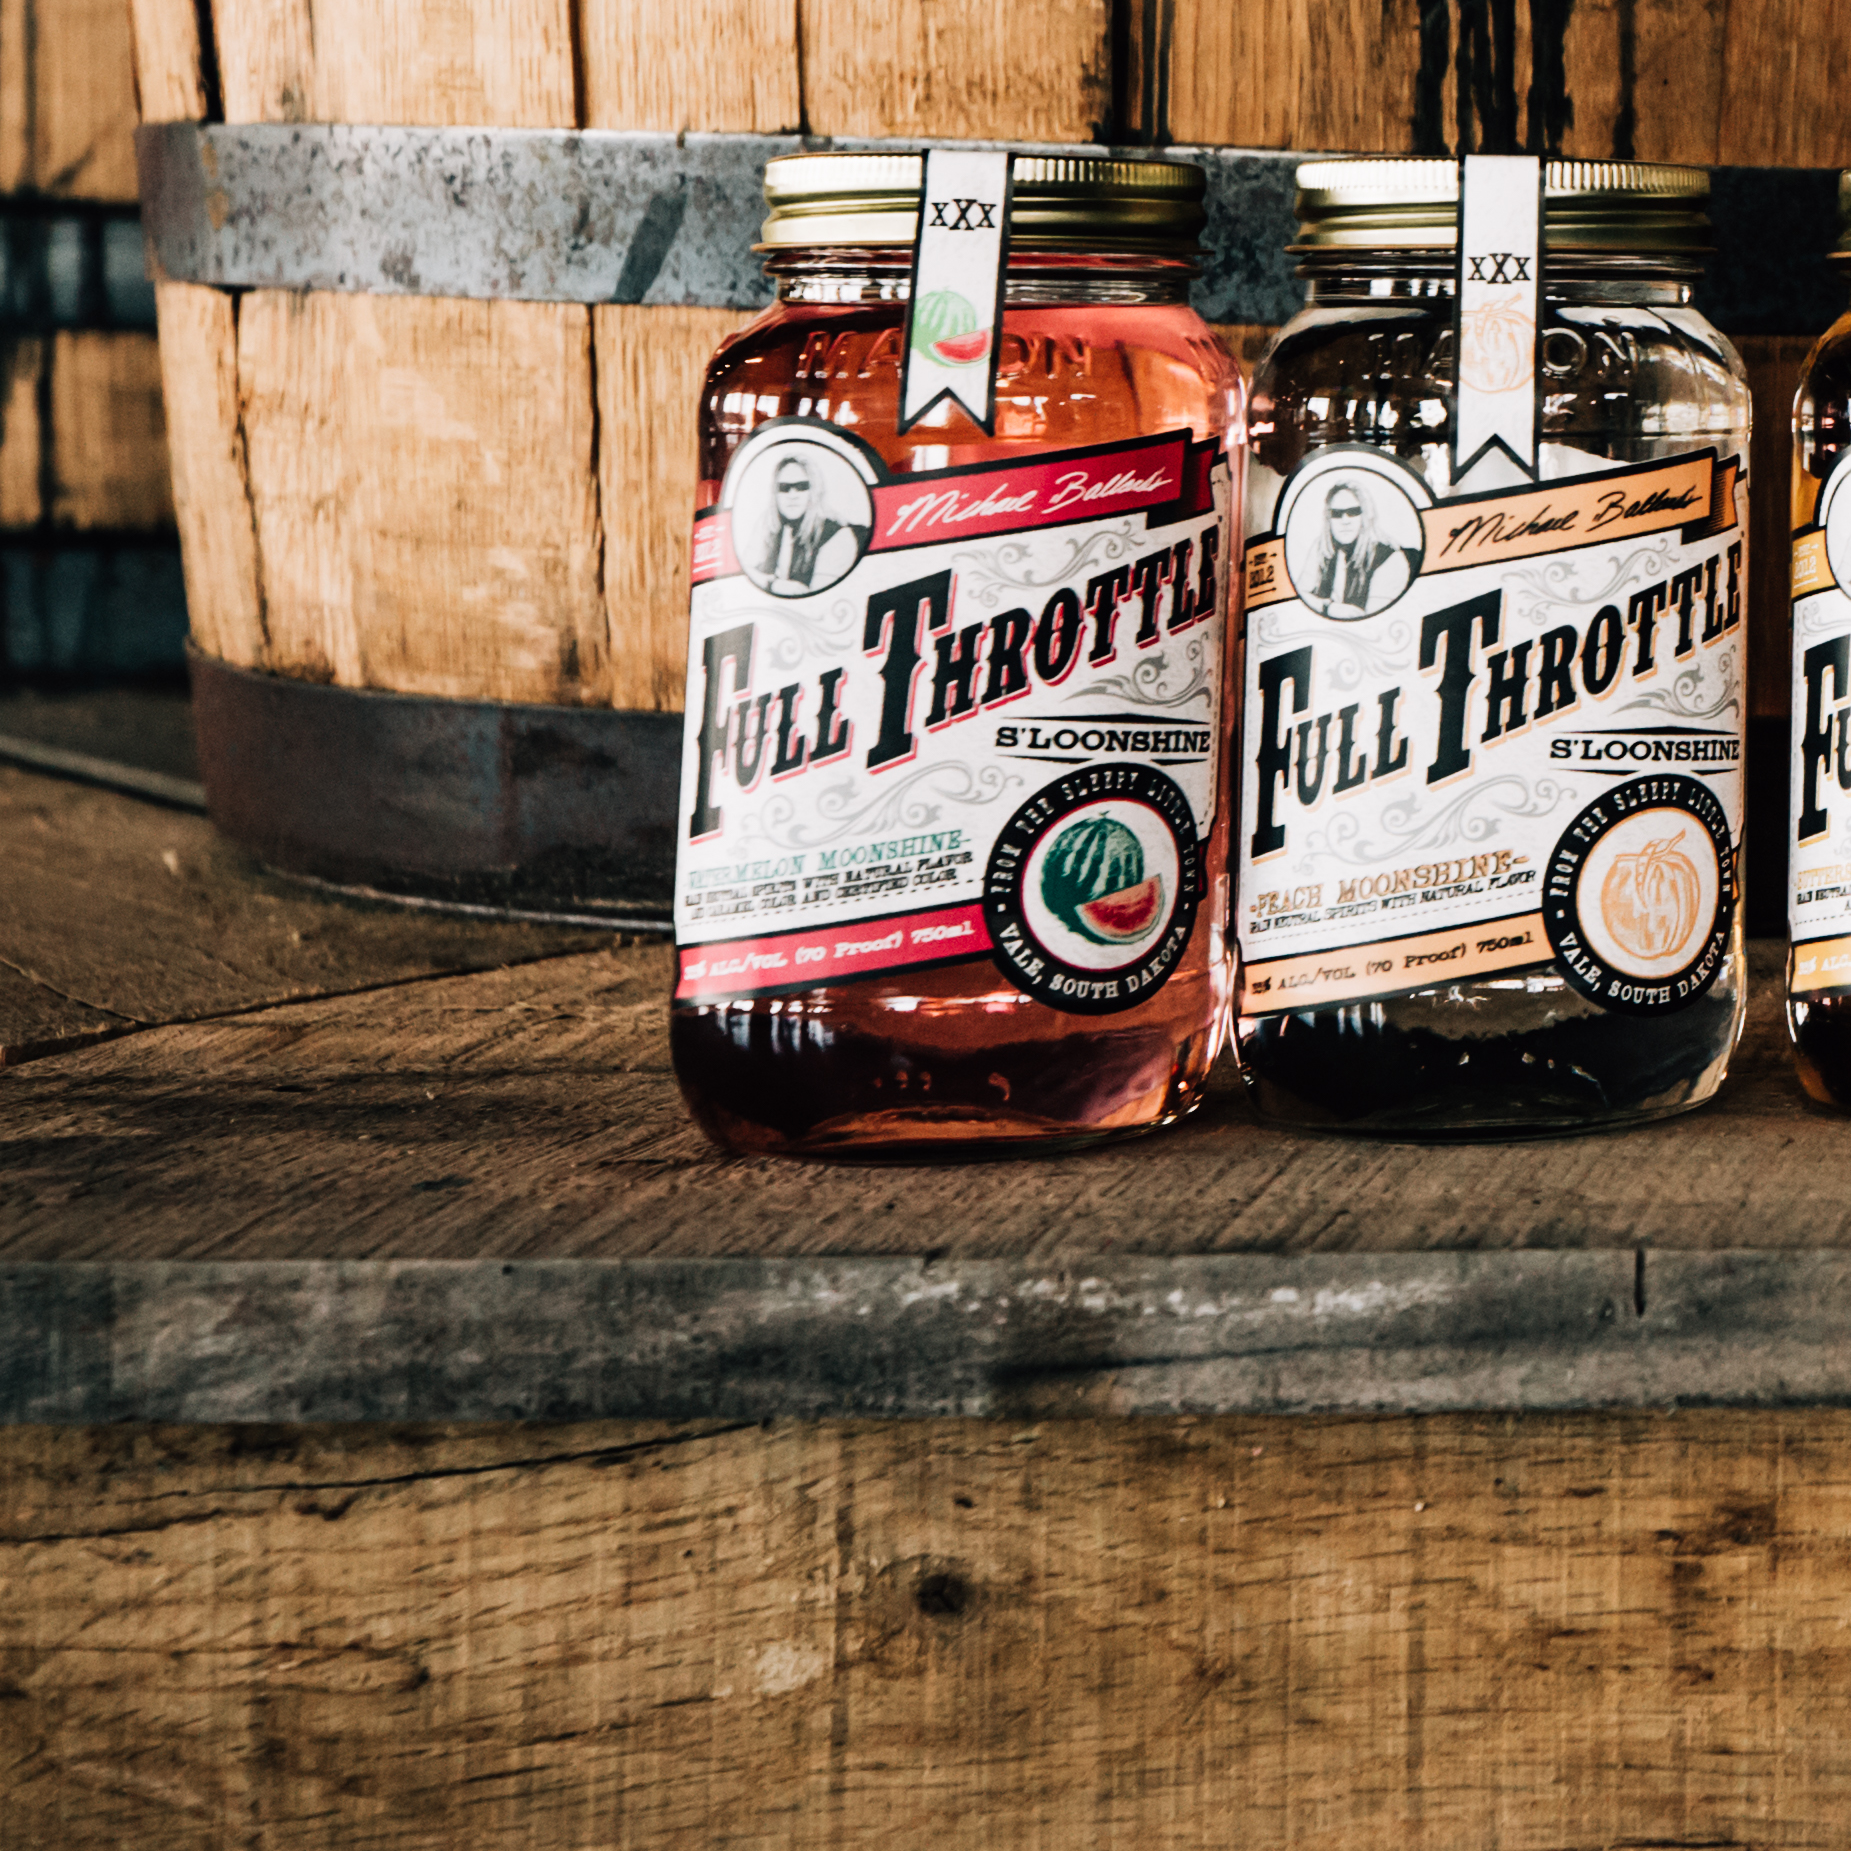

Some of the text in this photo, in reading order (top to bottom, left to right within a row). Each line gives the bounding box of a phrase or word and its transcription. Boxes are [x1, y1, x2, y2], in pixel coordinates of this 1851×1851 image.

[689, 525, 1218, 846] FULL THROTTLE
[1251, 541, 1743, 865] FULL THROTTLE
[995, 726, 1210, 753] S'LOONSHINE
[1550, 739, 1739, 761] S'LOONSHINE
[794, 920, 976, 966] (70 Proof) 750ml
[1000, 923, 1186, 999] VALE, SOUTH DAKOTA
[1366, 932, 1534, 977] (70 Proof) 750ml
[1559, 932, 1725, 1004] VALE, SOUTH DAKOTA
